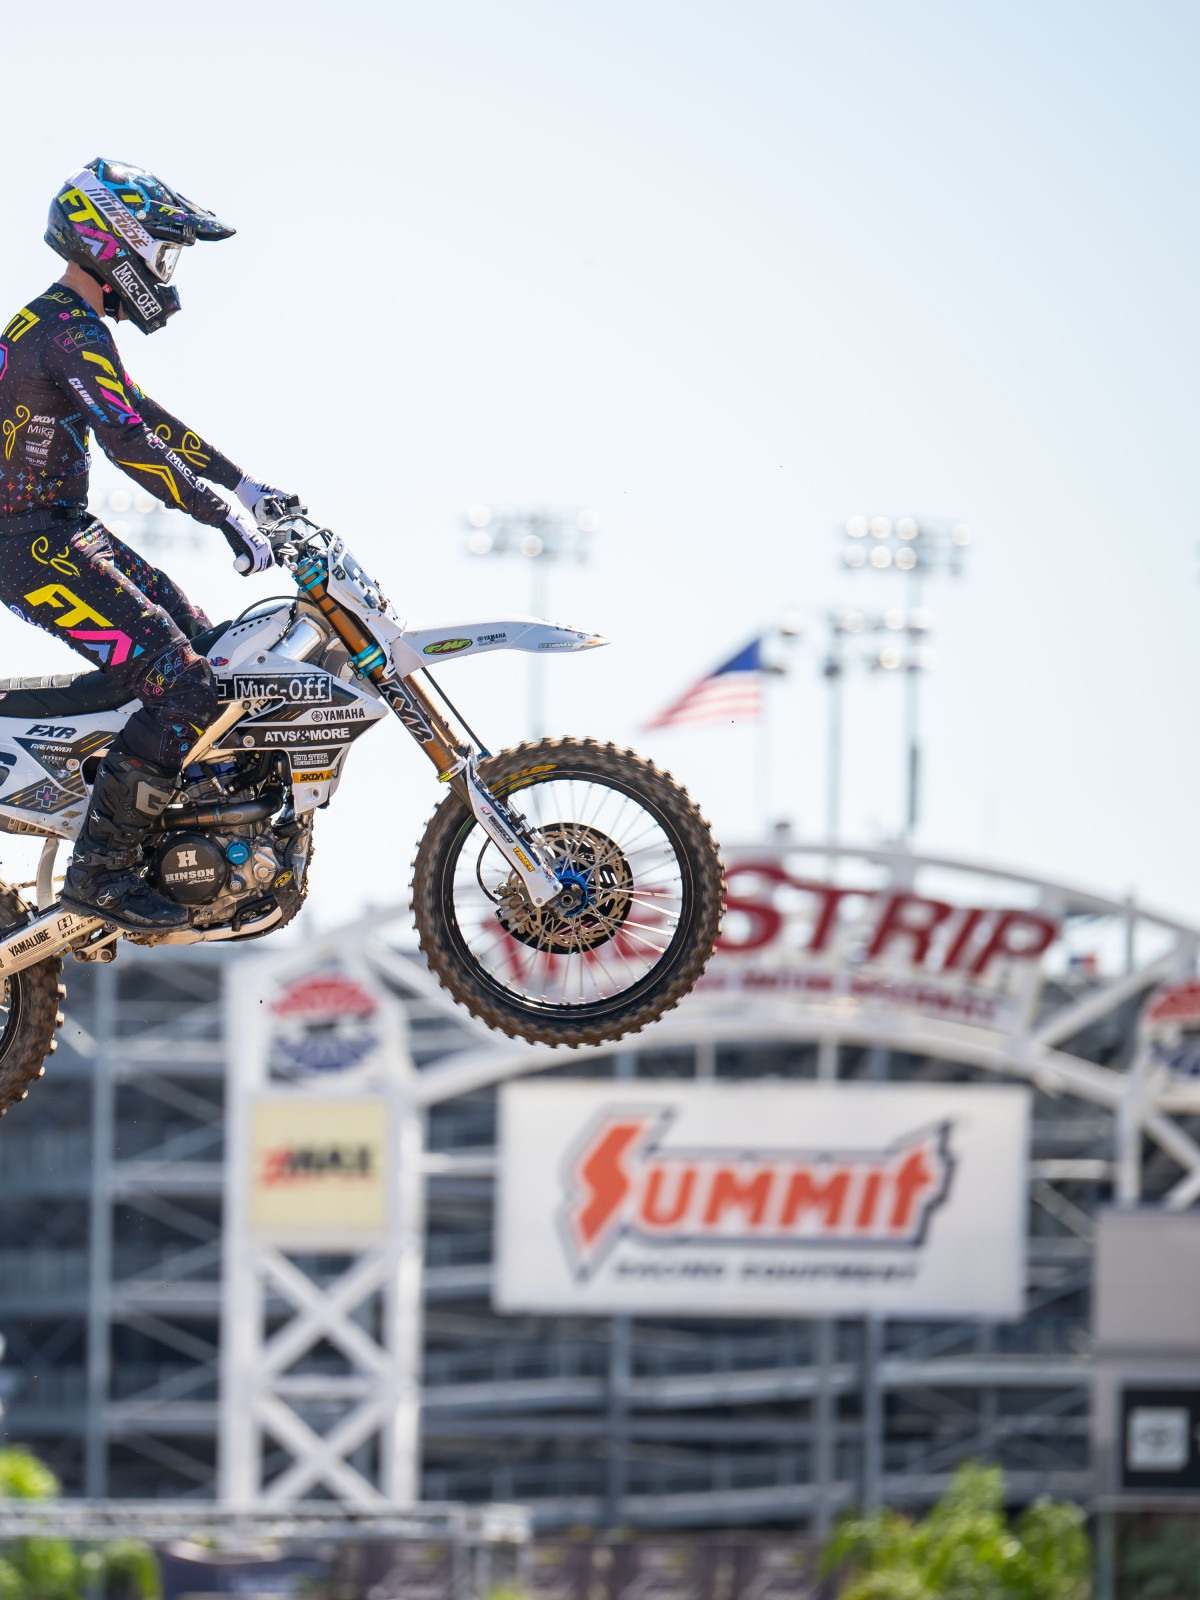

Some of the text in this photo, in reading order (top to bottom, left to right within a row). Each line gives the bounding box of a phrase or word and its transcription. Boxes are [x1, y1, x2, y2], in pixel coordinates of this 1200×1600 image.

[115, 265, 161, 317] Muc-Off
[483, 632, 507, 641] YAMAHA
[425, 639, 473, 654] FMF
[238, 676, 327, 700] Muc-Off
[323, 707, 366, 721] YAMAHA
[377, 679, 434, 744] KYB
[25, 724, 77, 740] FXR
[300, 773, 324, 782] SKDA
[165, 868, 215, 883] HINSON
[8, 928, 51, 957] YAMALUBE
